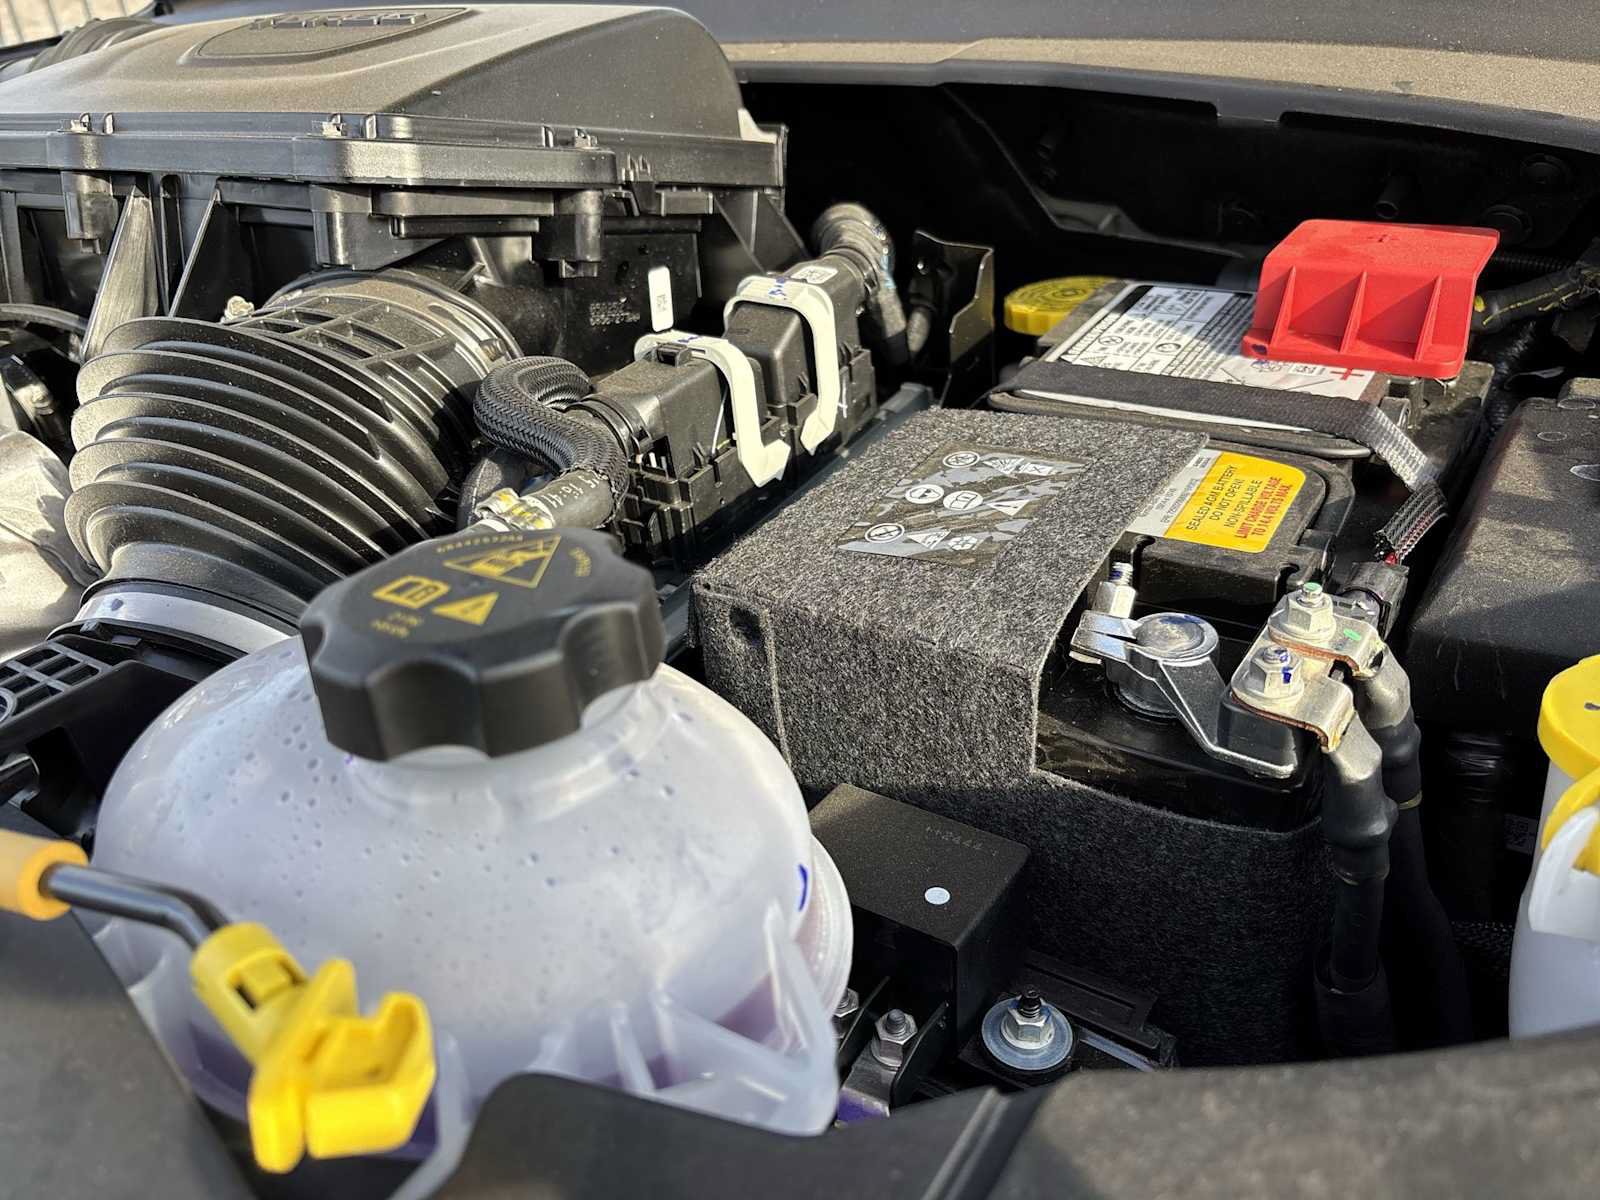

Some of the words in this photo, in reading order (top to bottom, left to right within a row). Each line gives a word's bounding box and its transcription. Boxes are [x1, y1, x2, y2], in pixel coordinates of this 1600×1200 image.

[1185, 505, 1211, 530] SEALED
[1202, 490, 1220, 506] AGM
[1212, 464, 1238, 491] BATTERY
[1208, 510, 1223, 521] DO
[1215, 496, 1231, 510] NOT
[1222, 479, 1262, 527] NON-SPILLABLE
[1233, 521, 1254, 538] LIMIT
[1244, 500, 1267, 522] CHARGE
[1257, 476, 1281, 500] VOLTAGE
[1251, 527, 1266, 536] TO
[1264, 496, 1283, 514] VOLTS
